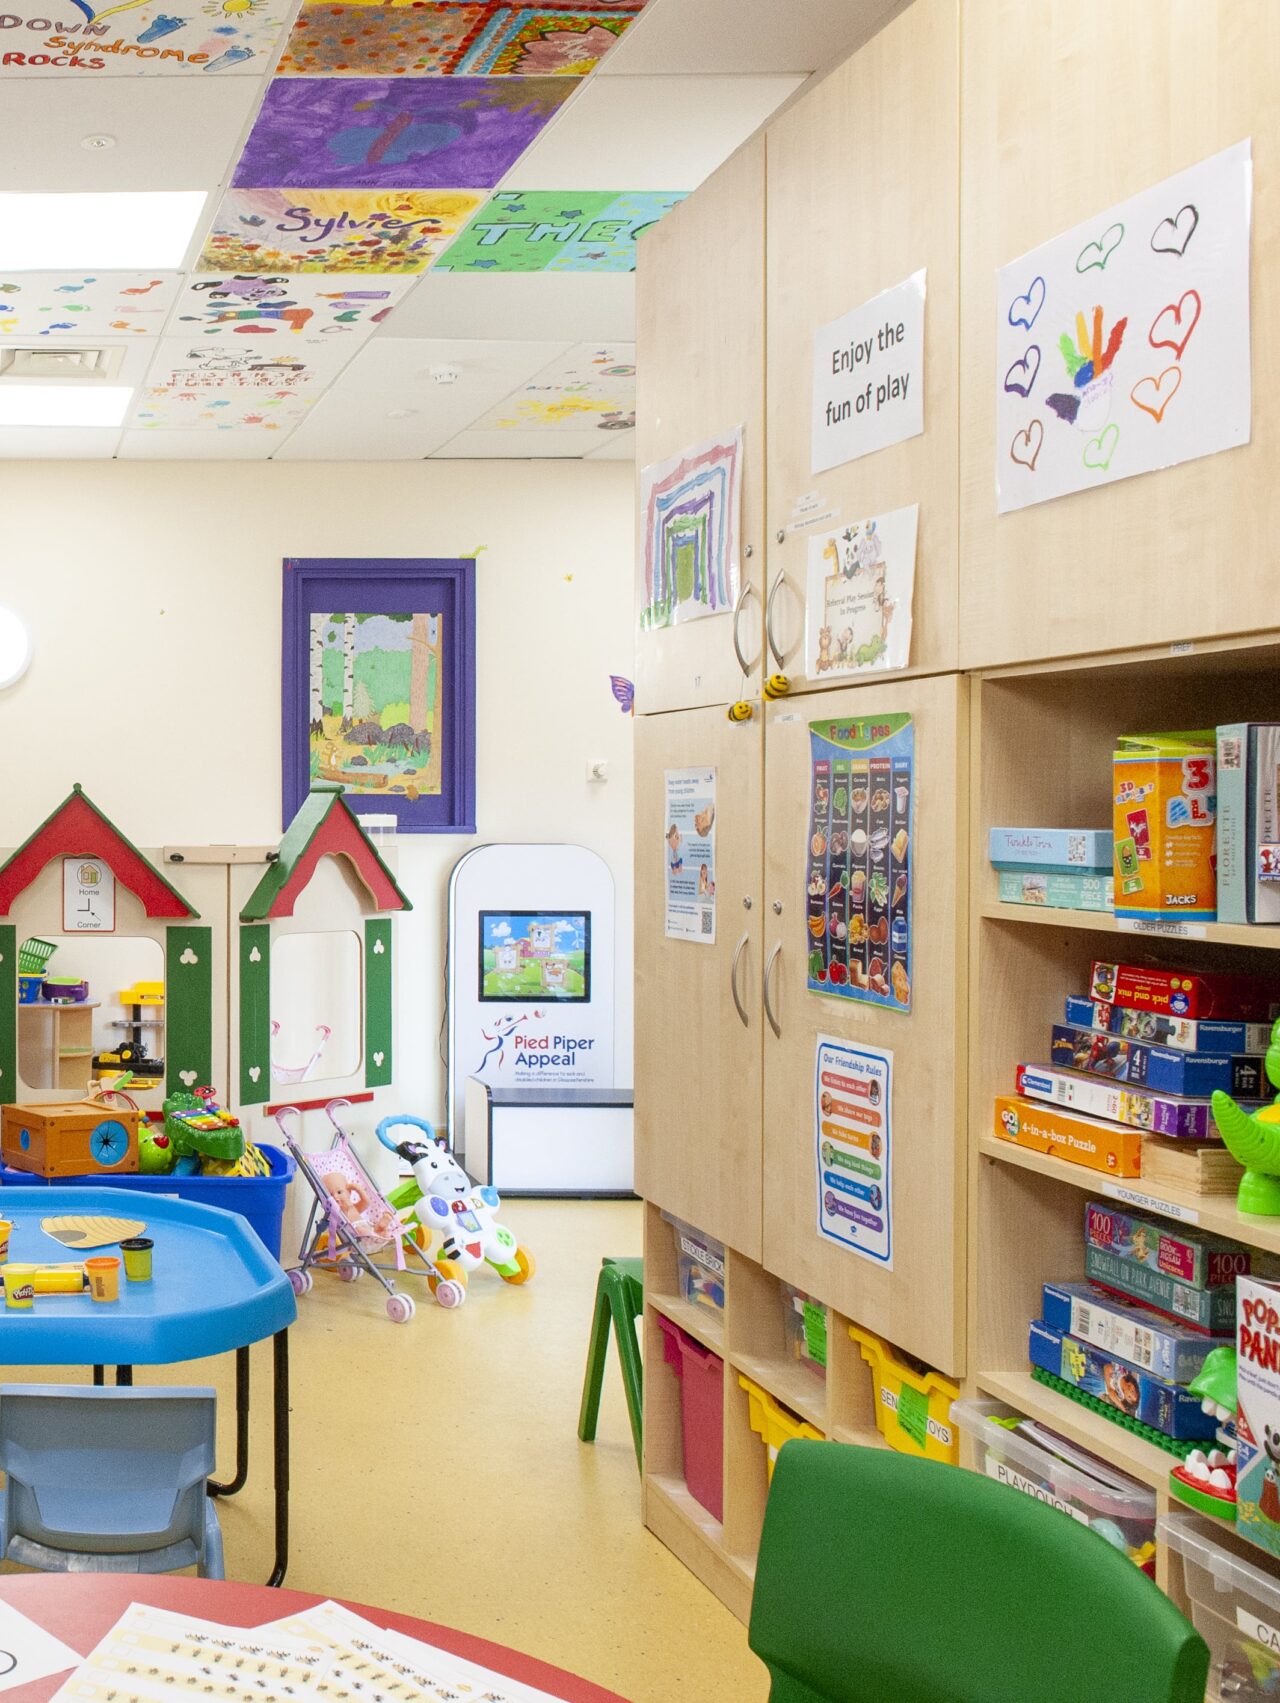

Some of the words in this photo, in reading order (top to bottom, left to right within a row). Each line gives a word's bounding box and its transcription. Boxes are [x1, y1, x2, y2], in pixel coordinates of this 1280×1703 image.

[276, 208, 440, 243] Sylvie
[832, 337, 873, 375] Enjoy
[877, 321, 905, 352] the
[826, 400, 851, 427] fun
[856, 383, 872, 414] of
[877, 372, 910, 411] play
[830, 723, 856, 741] Food
[858, 721, 890, 741] Types
[1169, 796, 1217, 823] AL
[1222, 805, 1231, 887] FLORETTE
[1083, 879, 1100, 889] 500
[1165, 895, 1197, 905] JACKS
[77, 921, 101, 929] Corner
[1133, 921, 1157, 933] OLDER
[1157, 922, 1188, 936] PUZZLES
[1118, 989, 1132, 999] mix
[1134, 991, 1150, 1001] and
[1152, 994, 1169, 1004] pick
[1200, 1024, 1243, 1034] Ravensburger
[515, 1035, 549, 1049] Pied
[553, 1035, 595, 1052] Piper
[515, 1051, 575, 1068] Appeal
[823, 1053, 834, 1064] Our
[835, 1056, 865, 1075] Friendship
[865, 1062, 882, 1077] Rules
[1133, 1050, 1141, 1066] 4
[1185, 1056, 1229, 1066] Ravensburger
[1240, 1064, 1258, 1075] 4
[1022, 1122, 1067, 1146] 4-in-a-box
[1068, 1135, 1097, 1153] Puzzle
[1117, 1188, 1149, 1206] YOUNGER
[1150, 1199, 1182, 1216] PUZZLES
[1091, 1211, 1111, 1235] 100
[1091, 1251, 1119, 1279] SNOWFALL
[1131, 1267, 1147, 1289] PARK
[1159, 1261, 1184, 1276] Unicorns
[1212, 1254, 1245, 1275] 100
[1209, 1273, 1236, 1284] PIEC
[1217, 1299, 1235, 1316] SNO
[1239, 1323, 1280, 1375] PAN
[881, 1388, 898, 1411] SEN
[1257, 1623, 1280, 1652] CA
